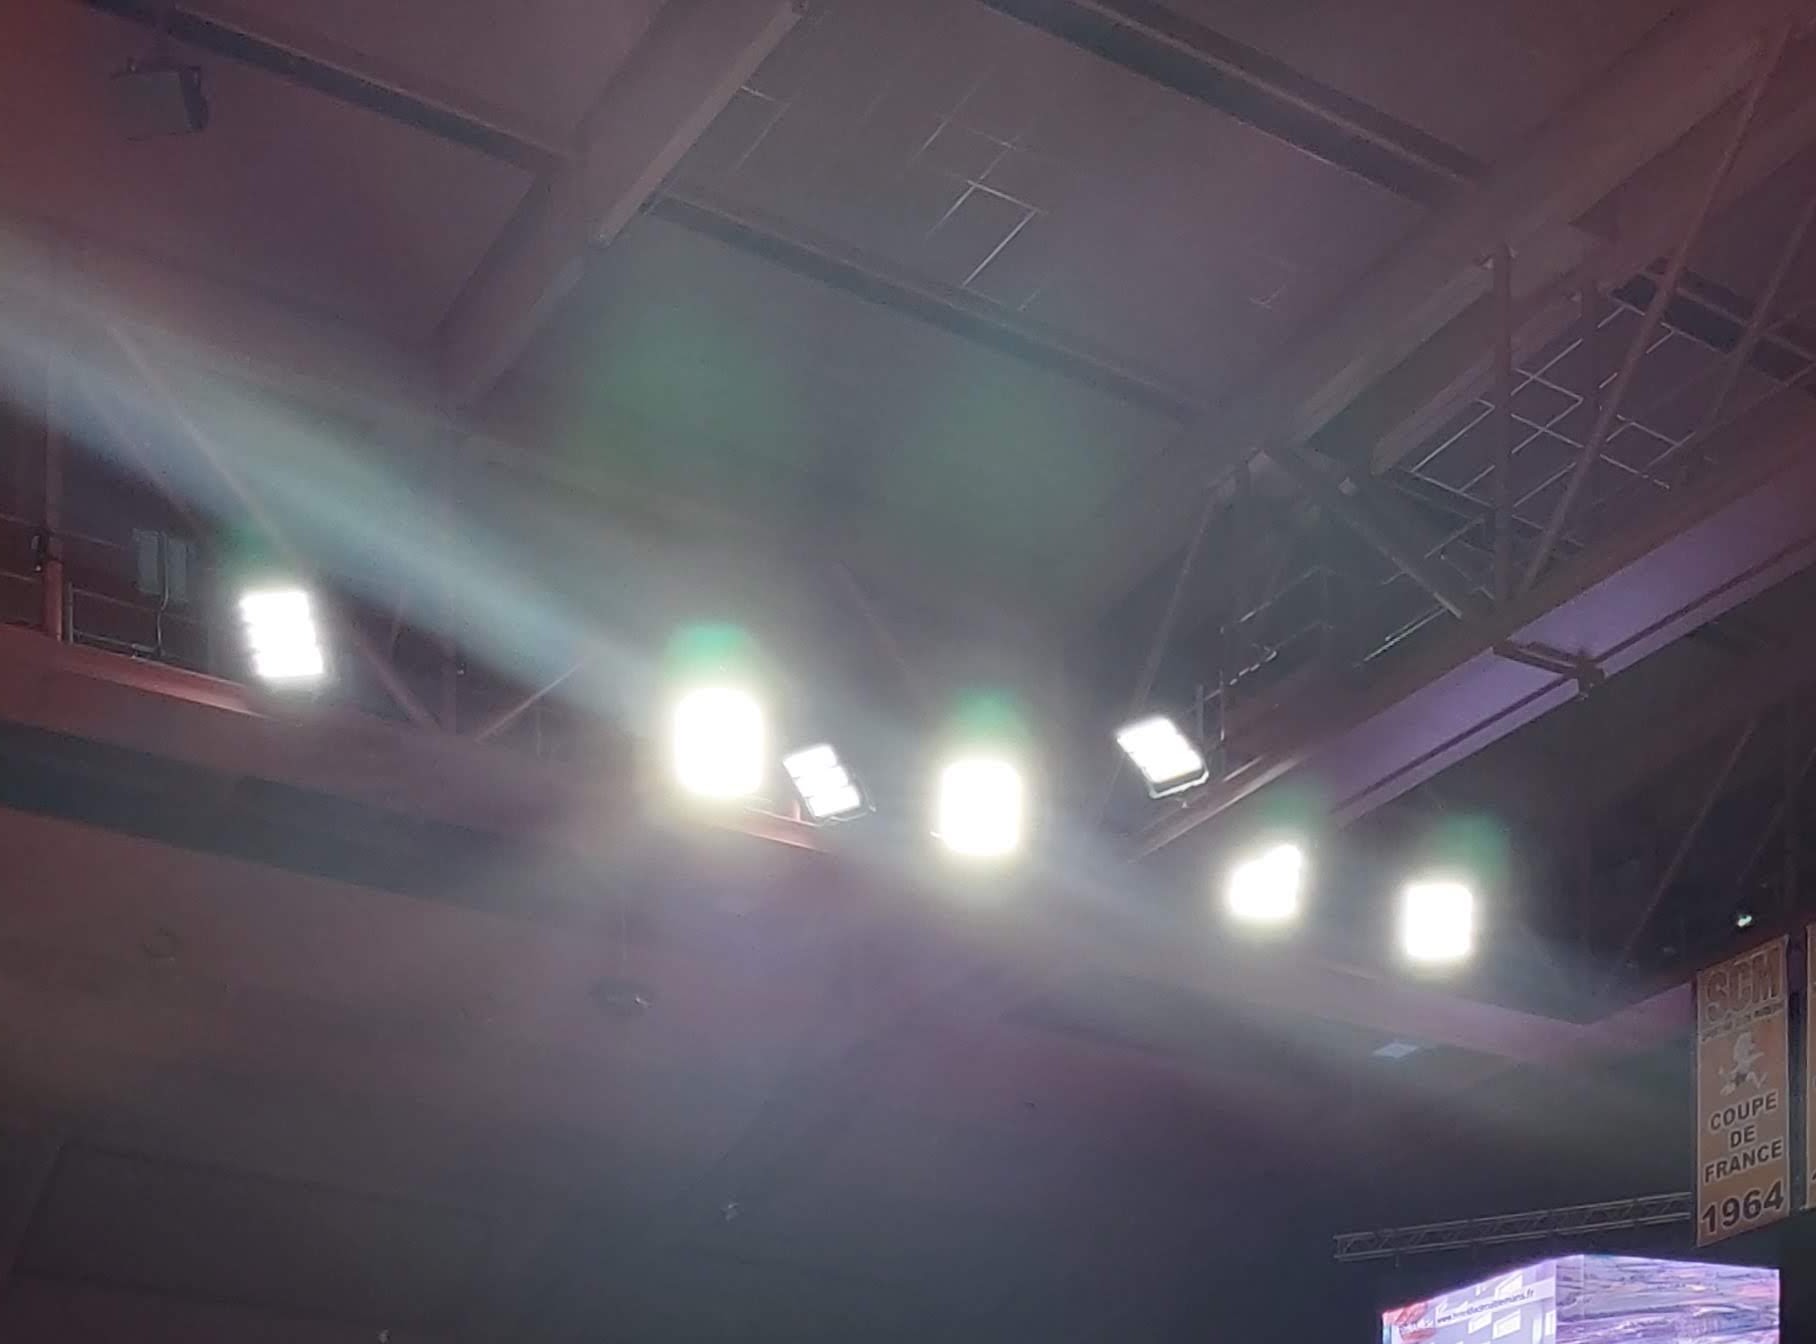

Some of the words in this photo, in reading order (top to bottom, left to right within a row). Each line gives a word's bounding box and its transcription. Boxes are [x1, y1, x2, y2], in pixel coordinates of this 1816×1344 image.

[1710, 1092, 1777, 1131] COUPE
[1730, 1125, 1756, 1149] DE
[1704, 1140, 1782, 1184] FRANCE
[1702, 1180, 1784, 1233] 1964
